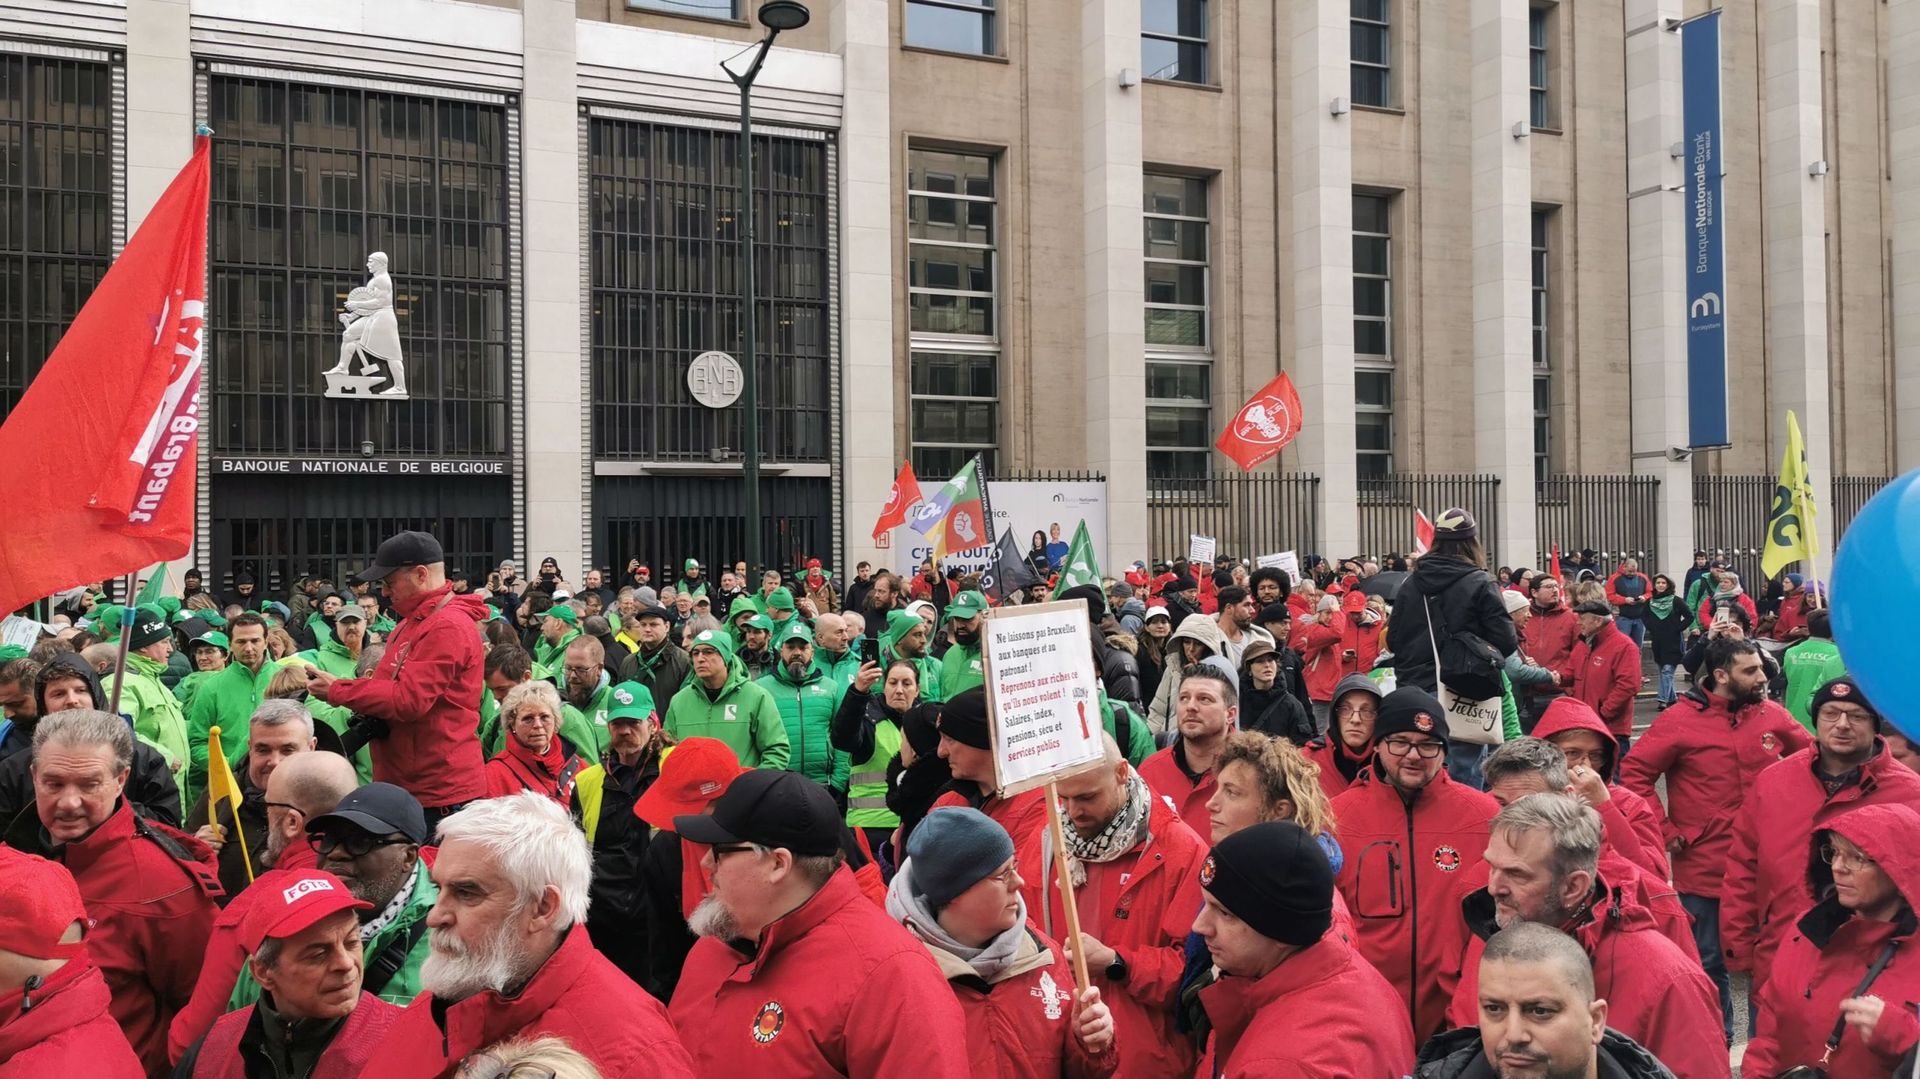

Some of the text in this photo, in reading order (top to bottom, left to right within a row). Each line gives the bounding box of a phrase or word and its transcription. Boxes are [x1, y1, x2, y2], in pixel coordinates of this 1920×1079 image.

[222, 460, 503, 474] BANQUE NATIONALE DE BELGIQUE
[996, 624, 1077, 644] Ne laissons pas Bruxelles
[998, 643, 1056, 660] aux banques et au
[1000, 664, 1028, 680] patronat
[1000, 671, 1079, 695] Reprenons aux riches ce
[1002, 698, 1021, 713] qu'ils
[1022, 695, 1038, 706] nous
[1039, 689, 1062, 702] volent
[1005, 708, 1055, 728] Salaires, index,
[1007, 730, 1038, 748] pensions,
[1055, 721, 1062, 731] et
[1008, 739, 1060, 762] services publics
[287, 880, 329, 899] FGTB
[764, 1002, 782, 1014] ABVV
[753, 1025, 779, 1042] METAAL
